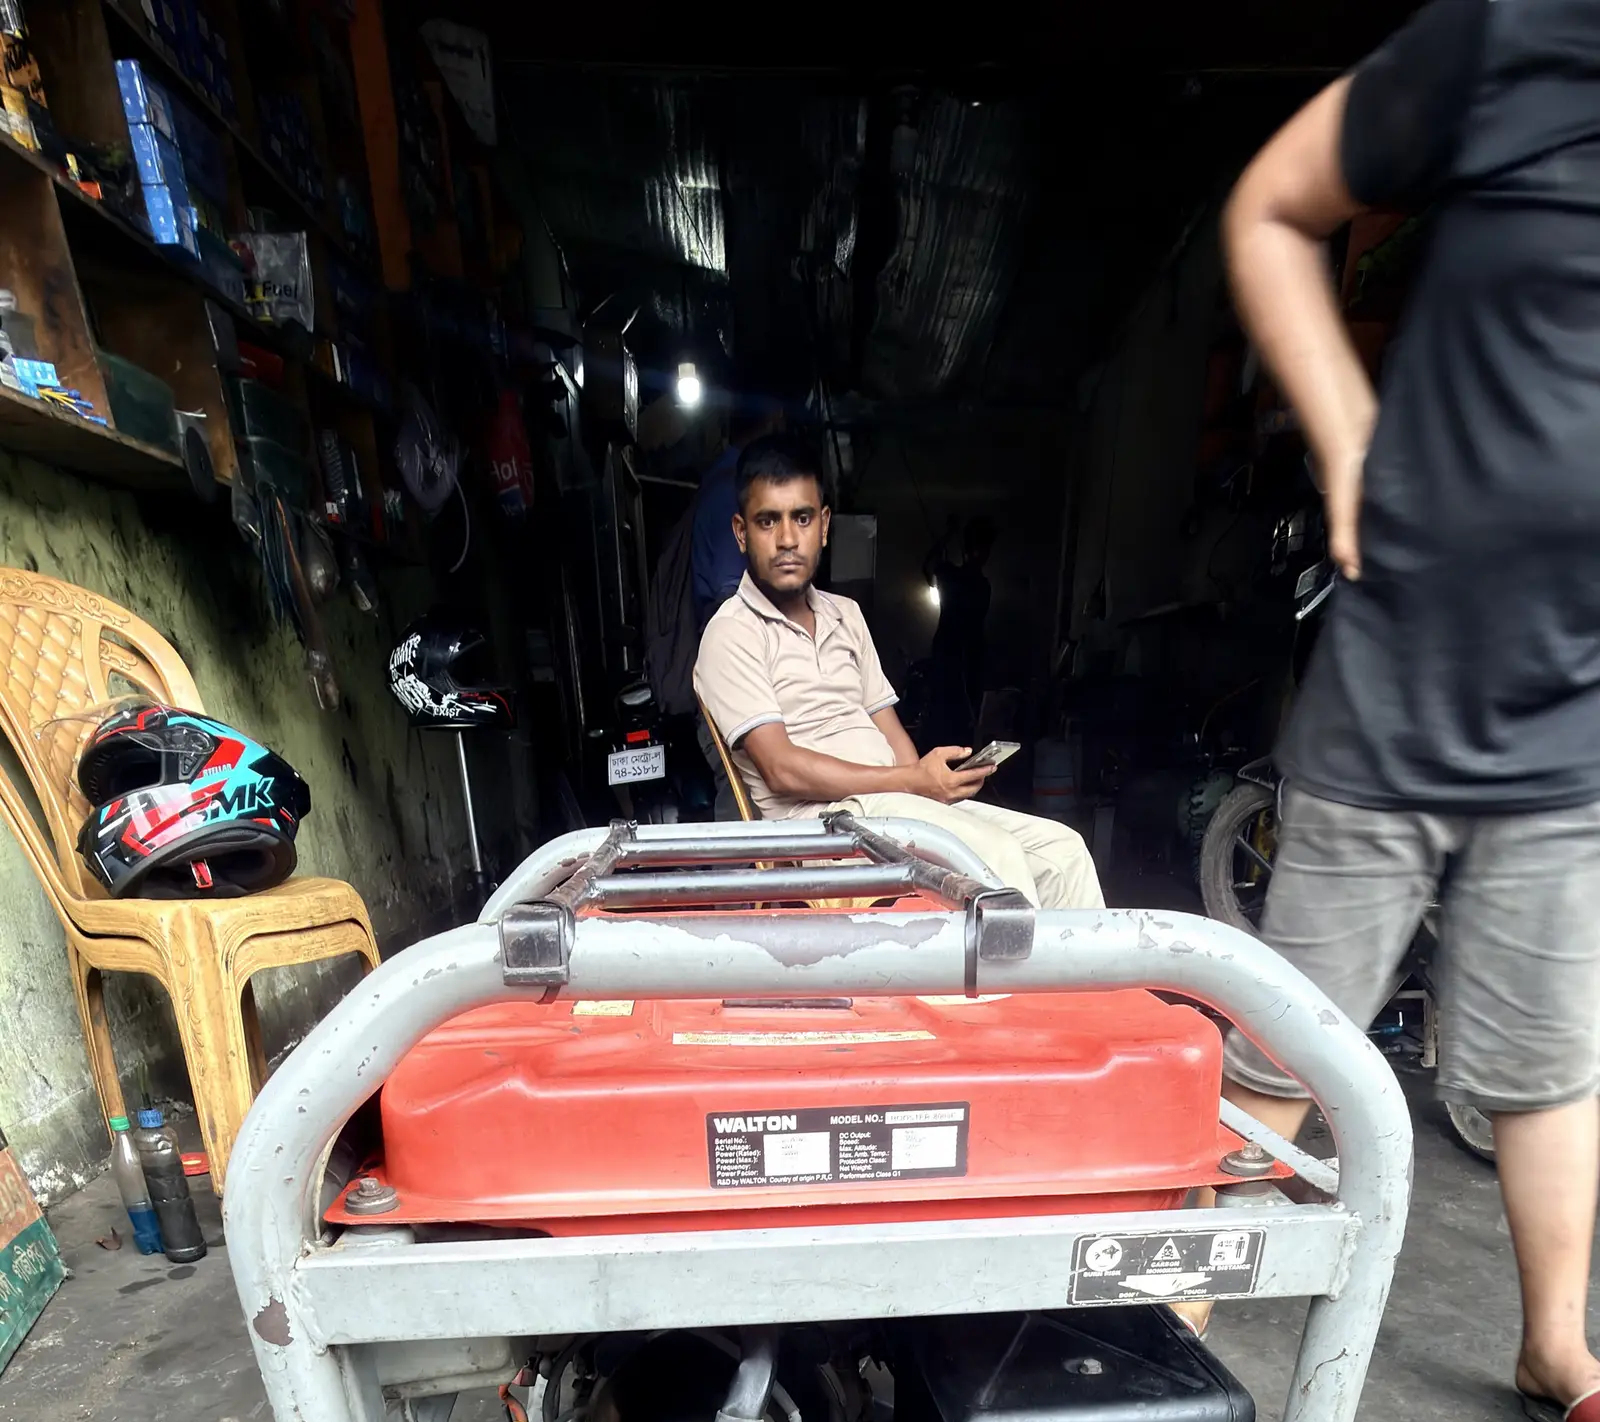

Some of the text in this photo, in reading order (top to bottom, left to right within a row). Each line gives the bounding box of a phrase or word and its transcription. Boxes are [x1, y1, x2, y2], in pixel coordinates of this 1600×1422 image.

[263, 281, 298, 299] Fuel
[433, 705, 461, 718] EXIST
[612, 756, 628, 766] ঢাকা
[714, 1115, 797, 1133] WALTON
[830, 1115, 863, 1124] MODEL
[865, 1114, 883, 1122] NO.:
[716, 1164, 751, 1172] Frequency:
[851, 1164, 872, 1172] Weight:
[732, 1178, 739, 1186] by
[769, 1175, 791, 1183] Country
[799, 1174, 814, 1182] origin
